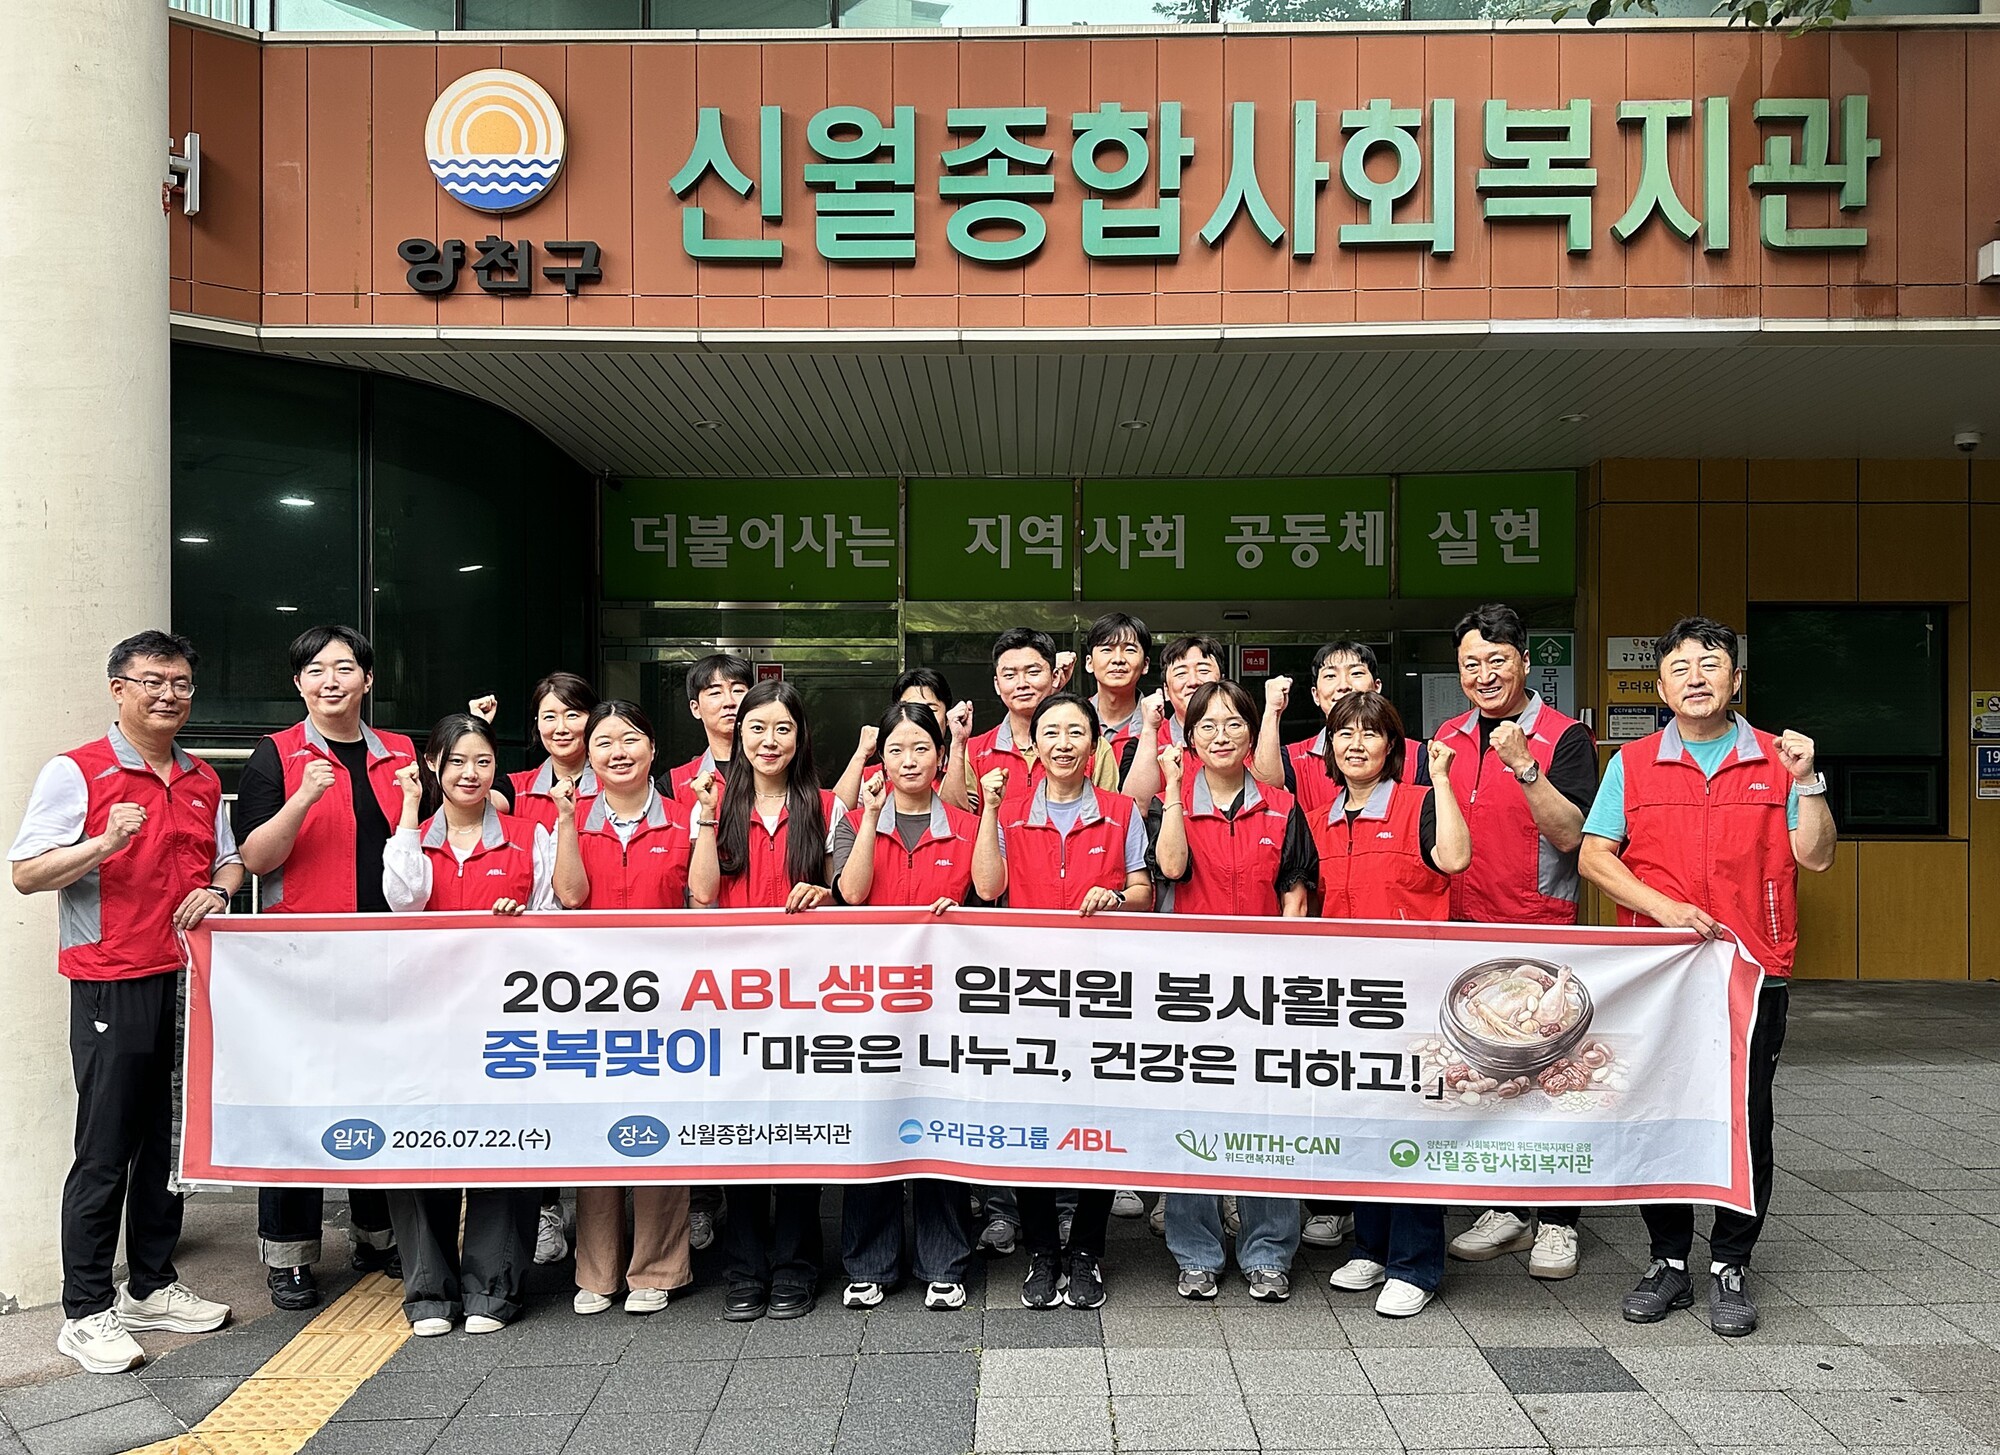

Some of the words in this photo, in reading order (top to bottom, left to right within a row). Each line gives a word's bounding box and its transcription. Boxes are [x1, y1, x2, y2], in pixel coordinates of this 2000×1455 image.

[669, 95, 1881, 265] 신월종합사회복지관
[397, 235, 603, 296] 양천구
[630, 513, 895, 569] 더불어사는
[1224, 510, 1385, 570] 공동체
[1428, 507, 1540, 565] 실현
[1617, 680, 1654, 694] 무더위
[1747, 782, 1770, 791] ABL
[1375, 831, 1395, 839] ABL
[649, 846, 669, 854] ABL
[1087, 845, 1107, 855] ABL
[485, 868, 507, 877] ABL
[934, 858, 954, 866] ABL
[502, 970, 660, 1014] 2026
[680, 963, 934, 1014] ABL생명
[954, 964, 1133, 1020] 임직원
[1153, 970, 1408, 1030] 봉사활동
[482, 1027, 721, 1080] 중복맞이
[919, 1034, 1072, 1083] 나누고,
[1090, 1040, 1237, 1085] 건강은
[332, 1127, 376, 1151] 일자
[391, 1128, 552, 1151] 2026.07.22.(수)
[617, 1124, 659, 1147] 장소
[677, 1123, 852, 1147] 신월종합사회복지관
[926, 1120, 1050, 1150] 우리금융그룹
[1056, 1127, 1128, 1154] ABL
[1223, 1132, 1341, 1155] WITH-CAN
[1465, 1140, 1515, 1151] 사회복지법인
[1424, 1150, 1594, 1174] 신월종합사회복지관
